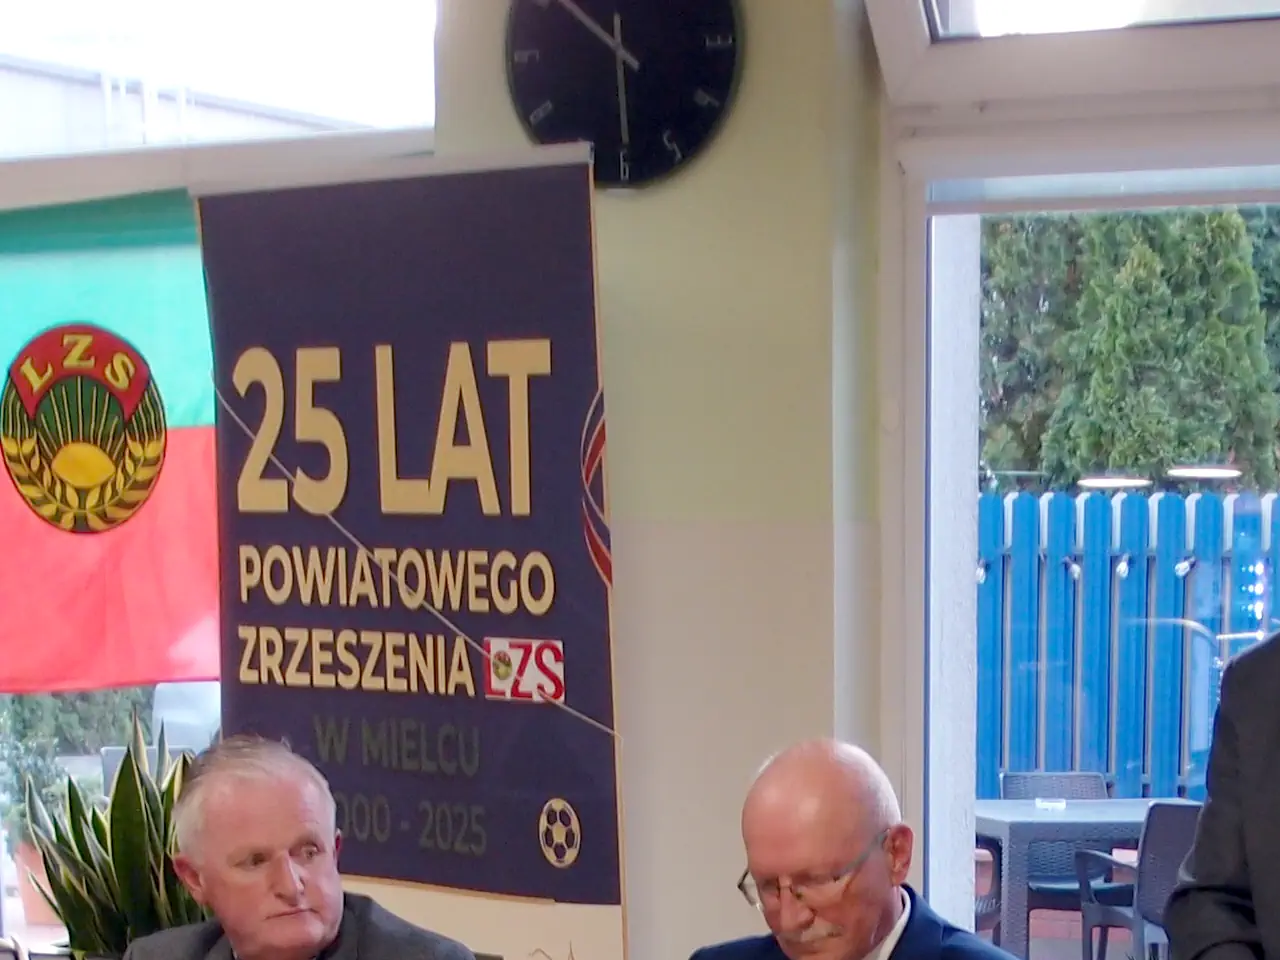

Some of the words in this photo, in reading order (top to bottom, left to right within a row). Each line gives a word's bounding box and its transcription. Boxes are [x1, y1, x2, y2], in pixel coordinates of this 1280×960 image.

[19, 333, 136, 396] LZS
[231, 345, 350, 516] 25
[374, 338, 552, 517] LAT
[237, 544, 556, 616] POWIATOWEGO
[237, 624, 476, 697] ZRZESZENIA
[484, 637, 565, 701] LZS
[312, 715, 350, 765] W
[360, 715, 481, 777] MIELCU
[334, 790, 392, 844] 000
[418, 799, 488, 858] 2025
